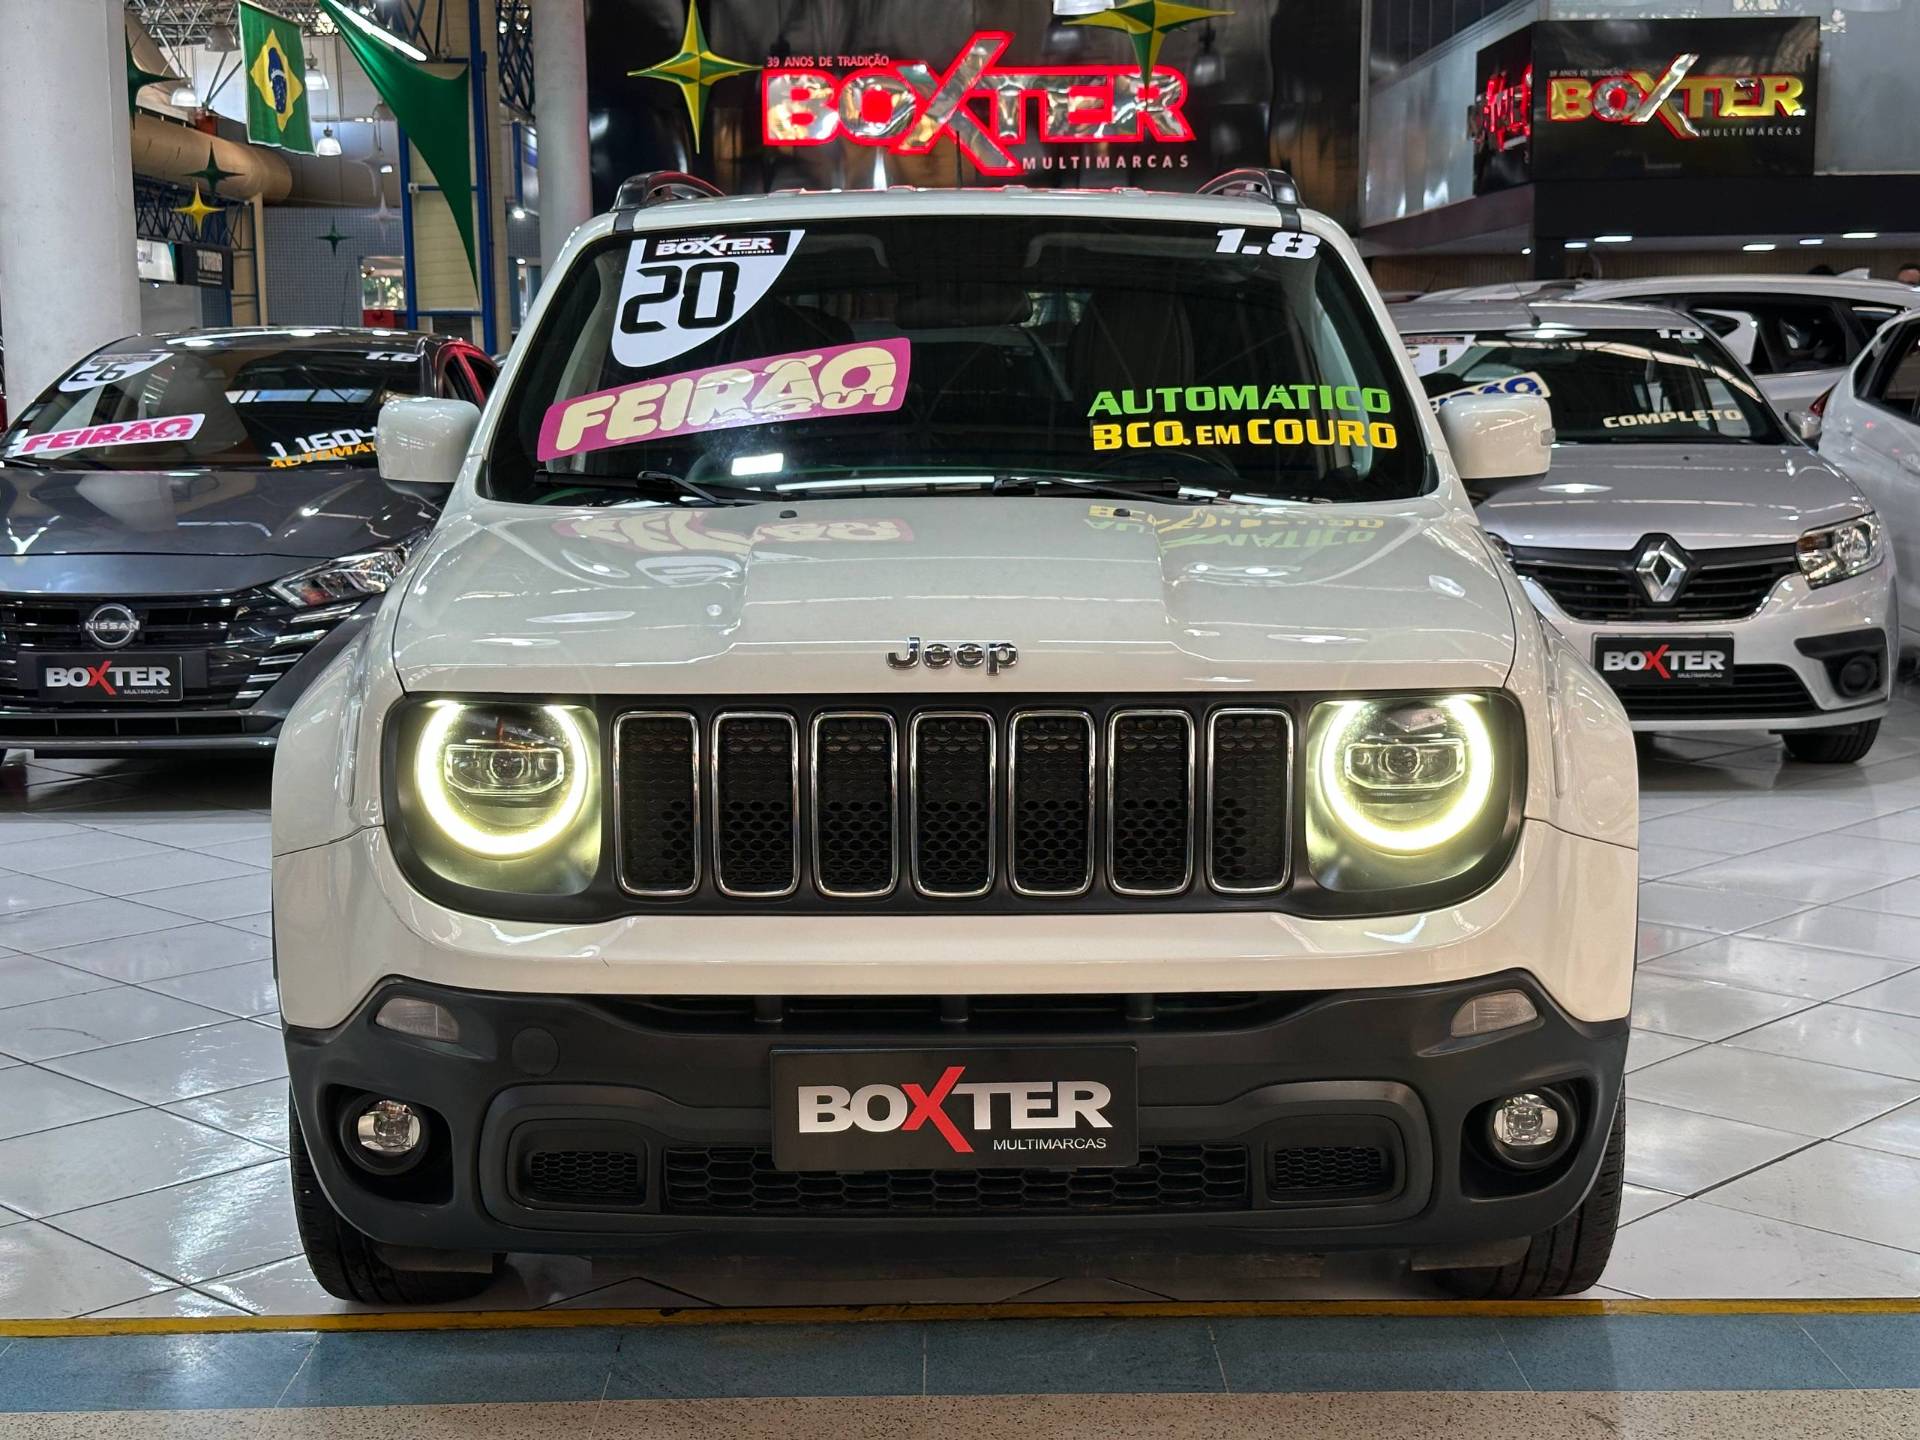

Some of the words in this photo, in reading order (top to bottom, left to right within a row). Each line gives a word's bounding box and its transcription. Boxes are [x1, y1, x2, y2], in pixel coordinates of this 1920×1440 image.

[767, 56, 780, 67] 39
[784, 56, 815, 67] ANOS
[818, 56, 833, 67] DE
[838, 53, 890, 68] TRADIÇÃO
[763, 30, 1197, 177] BOXTER
[1547, 53, 1806, 139] BOXTER
[1700, 127, 1801, 137] MULTIMARCAS
[1022, 156, 1190, 170] MULTIMARCAS
[655, 234, 773, 257] BOXTER
[1215, 228, 1321, 259] 1.8
[620, 261, 740, 334] 20
[68, 361, 127, 382] 26
[1087, 384, 1391, 417] AUTOMÁTICO
[1602, 409, 1744, 428] COMPLETO
[1092, 420, 1192, 450] BCO.
[1195, 424, 1241, 445] EM
[1247, 419, 1397, 449] COURO
[85, 620, 140, 631] NISSAN
[885, 636, 1019, 676] Jeep
[1603, 644, 1725, 679] BOXTER
[46, 660, 171, 695] BOXTER
[798, 1066, 1113, 1152] BOXTER
[993, 1137, 1107, 1151] MULTIMARCAS
